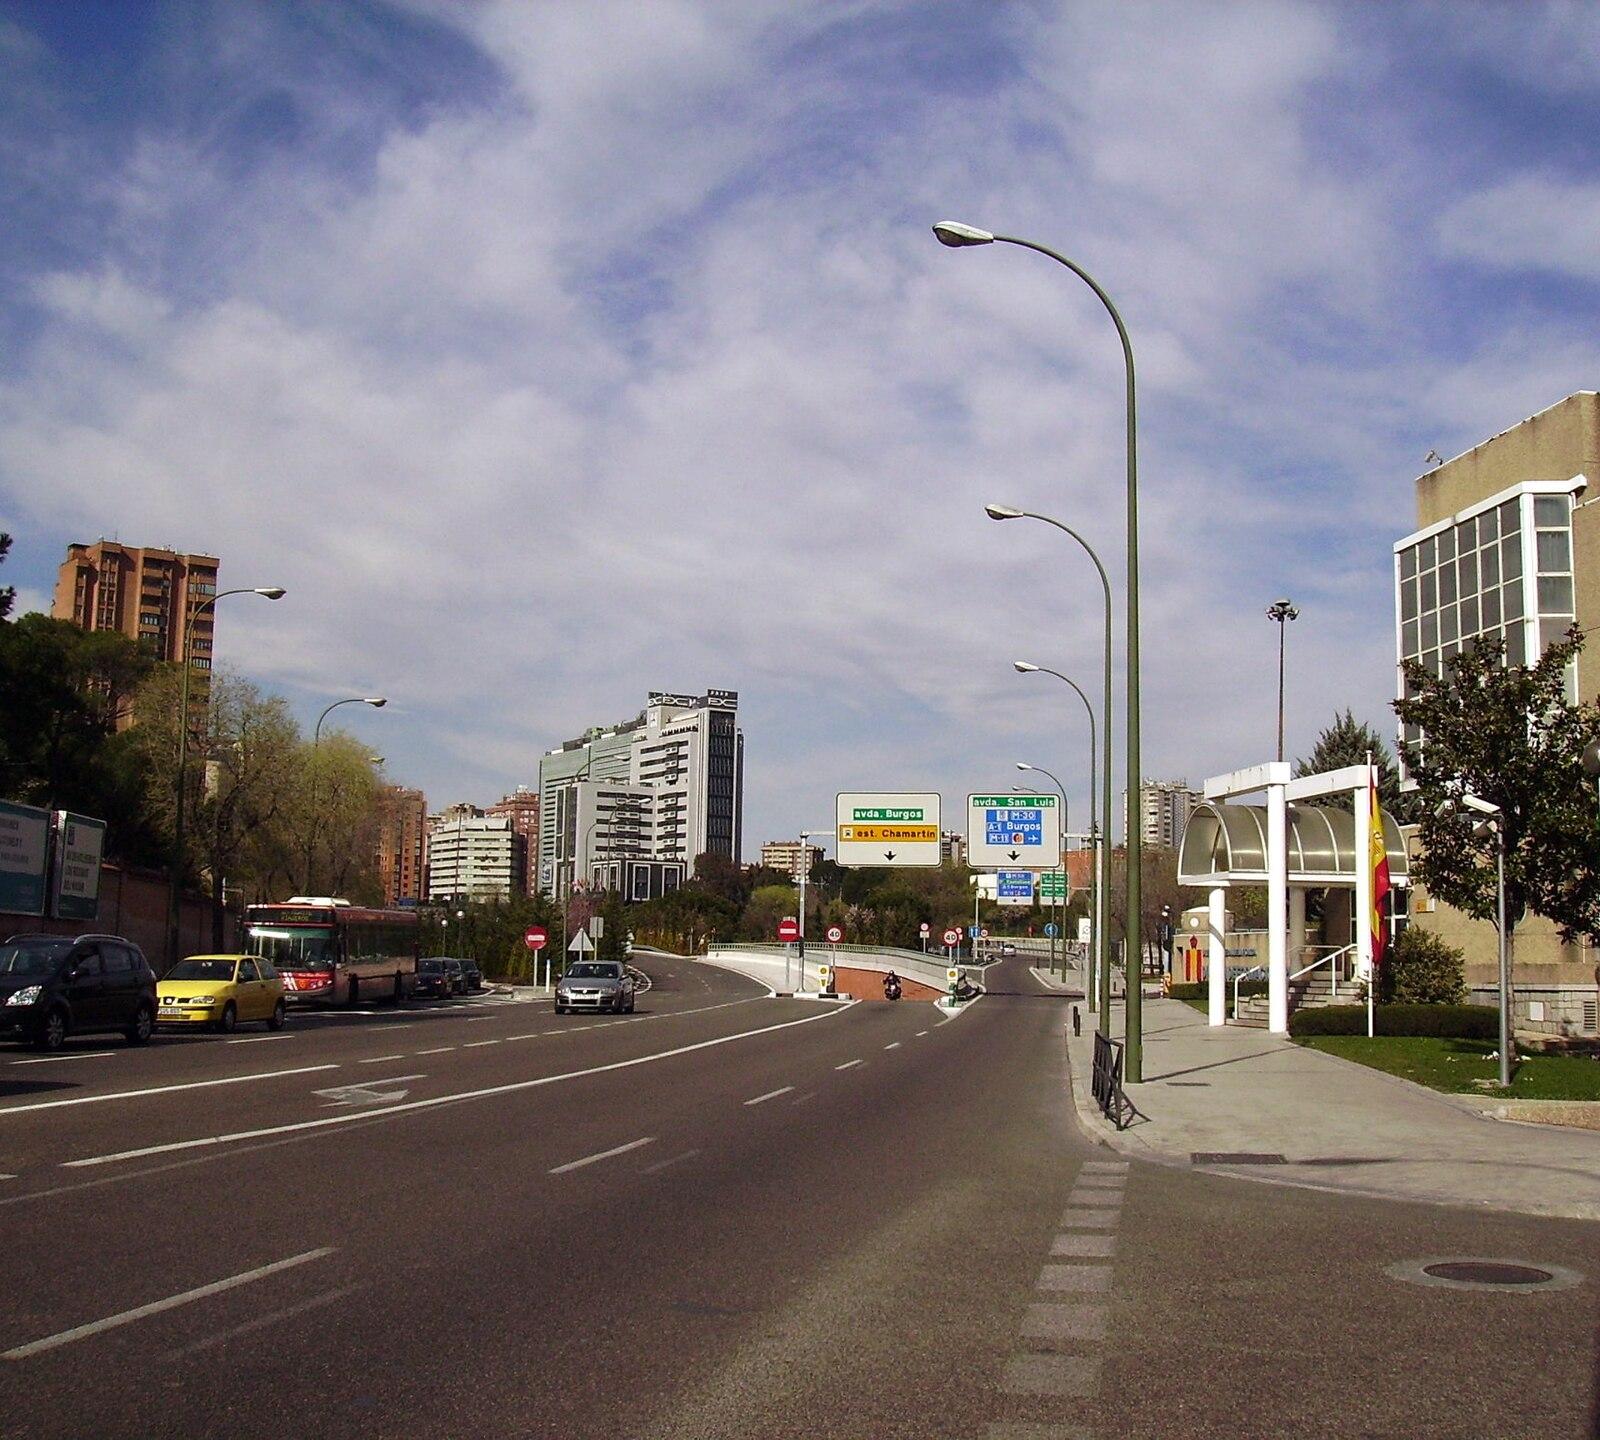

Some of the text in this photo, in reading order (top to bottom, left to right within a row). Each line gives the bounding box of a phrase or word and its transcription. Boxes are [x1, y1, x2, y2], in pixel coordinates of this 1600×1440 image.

[974, 798, 1054, 806] avda. San Luis
[855, 810, 922, 819] avda. Burgos
[1007, 822, 1041, 831] Burgos
[857, 829, 877, 838] est.
